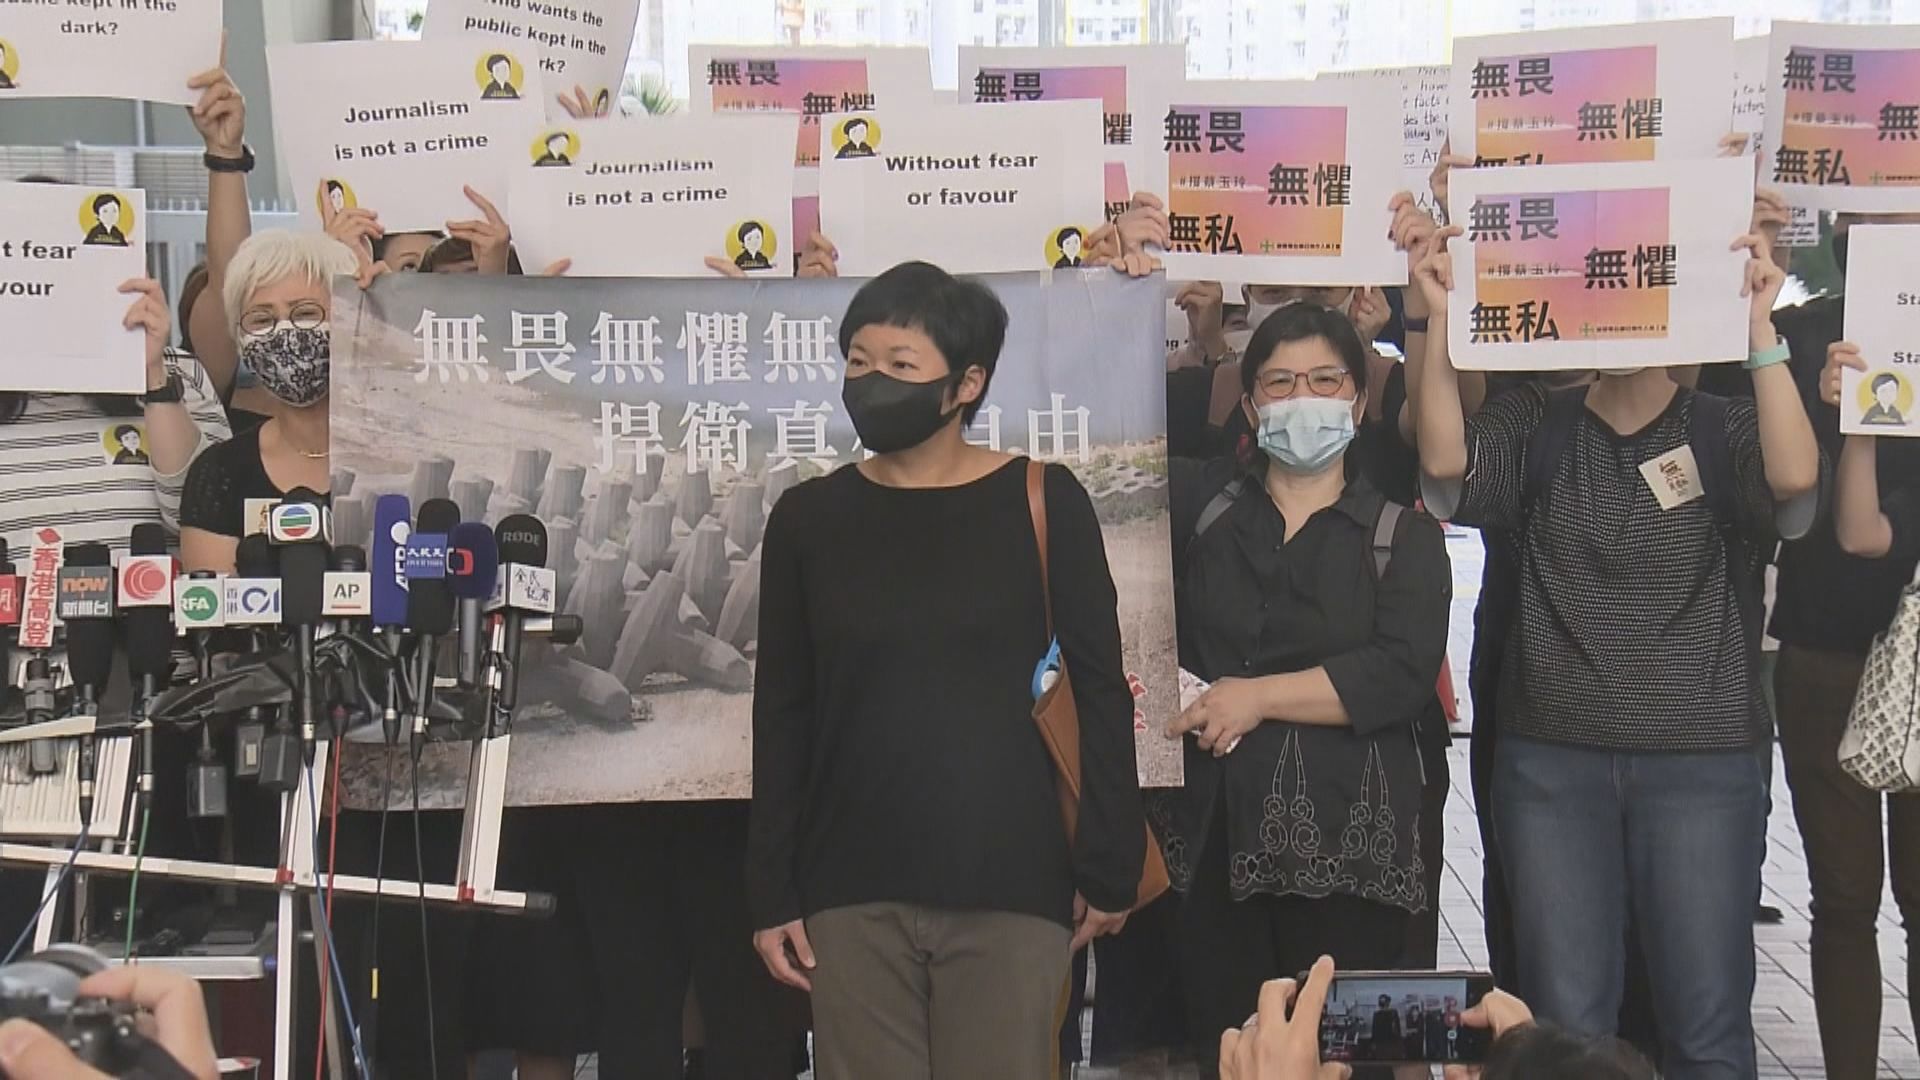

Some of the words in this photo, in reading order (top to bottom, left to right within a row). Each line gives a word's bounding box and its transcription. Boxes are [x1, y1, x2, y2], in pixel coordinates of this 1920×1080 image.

[60, 20, 118, 35] dark?
[527, 1, 578, 21] wants
[583, 11, 603, 27] the
[465, 15, 522, 37] public
[527, 26, 566, 47] kept
[571, 34, 584, 50] in
[588, 41, 606, 55] the
[707, 59, 780, 86] 無畏
[974, 70, 1044, 102] 無畏
[1471, 58, 1554, 99] 無畏
[1783, 51, 1856, 92] 無畏
[344, 101, 469, 123] Journalism
[1577, 98, 1663, 141] 無懼
[1878, 102, 1919, 141] 無
[335, 144, 353, 160] is
[361, 140, 397, 157] not
[404, 141, 417, 153] a
[424, 134, 488, 151] crime
[1164, 110, 1245, 153] 無畏
[585, 159, 713, 175] Journalism
[885, 154, 980, 171] Without
[989, 153, 1039, 168] fear
[1773, 145, 1850, 186] 無私
[568, 191, 586, 206] is
[595, 189, 632, 205] not
[641, 192, 653, 203] a
[662, 186, 728, 202] crime
[907, 192, 932, 205] or
[939, 188, 1018, 205] favour
[1267, 162, 1352, 206] 無懼
[1164, 212, 1243, 255] 無私
[1469, 198, 1559, 242] 無畏
[22, 241, 77, 259] fear
[1584, 244, 1678, 289] 無懼
[1470, 300, 1560, 344] 無私
[413, 308, 839, 386] 無畏無懼無
[62, 577, 109, 593] now
[334, 583, 360, 599] AP
